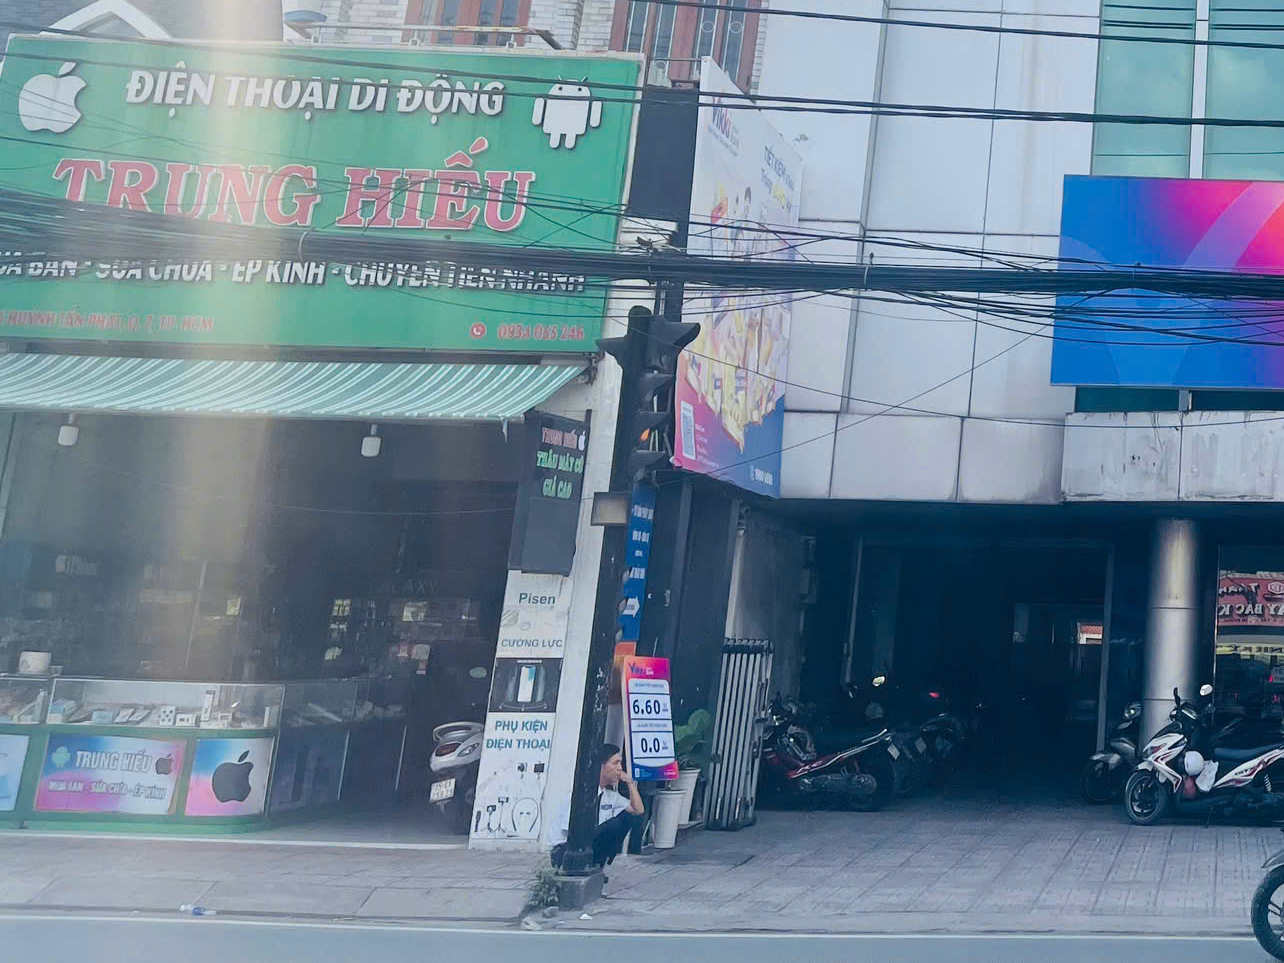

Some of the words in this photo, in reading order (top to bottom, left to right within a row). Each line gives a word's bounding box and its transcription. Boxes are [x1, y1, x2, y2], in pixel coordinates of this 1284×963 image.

[126, 61, 216, 117] ĐIỆN
[223, 75, 339, 121] THOẠI
[347, 78, 390, 112] DI
[397, 73, 505, 124] ĐỘNG
[53, 158, 321, 227] TRUNG
[335, 137, 536, 232] HIẾU
[518, 592, 556, 605] Pisen
[632, 699, 661, 715] 6.60
[494, 720, 518, 734] PHỤ
[521, 719, 548, 734] KIỆN
[640, 737, 661, 753] 0.0
[75, 750, 119, 770] TRUNG
[121, 748, 152, 773] HIẾU
